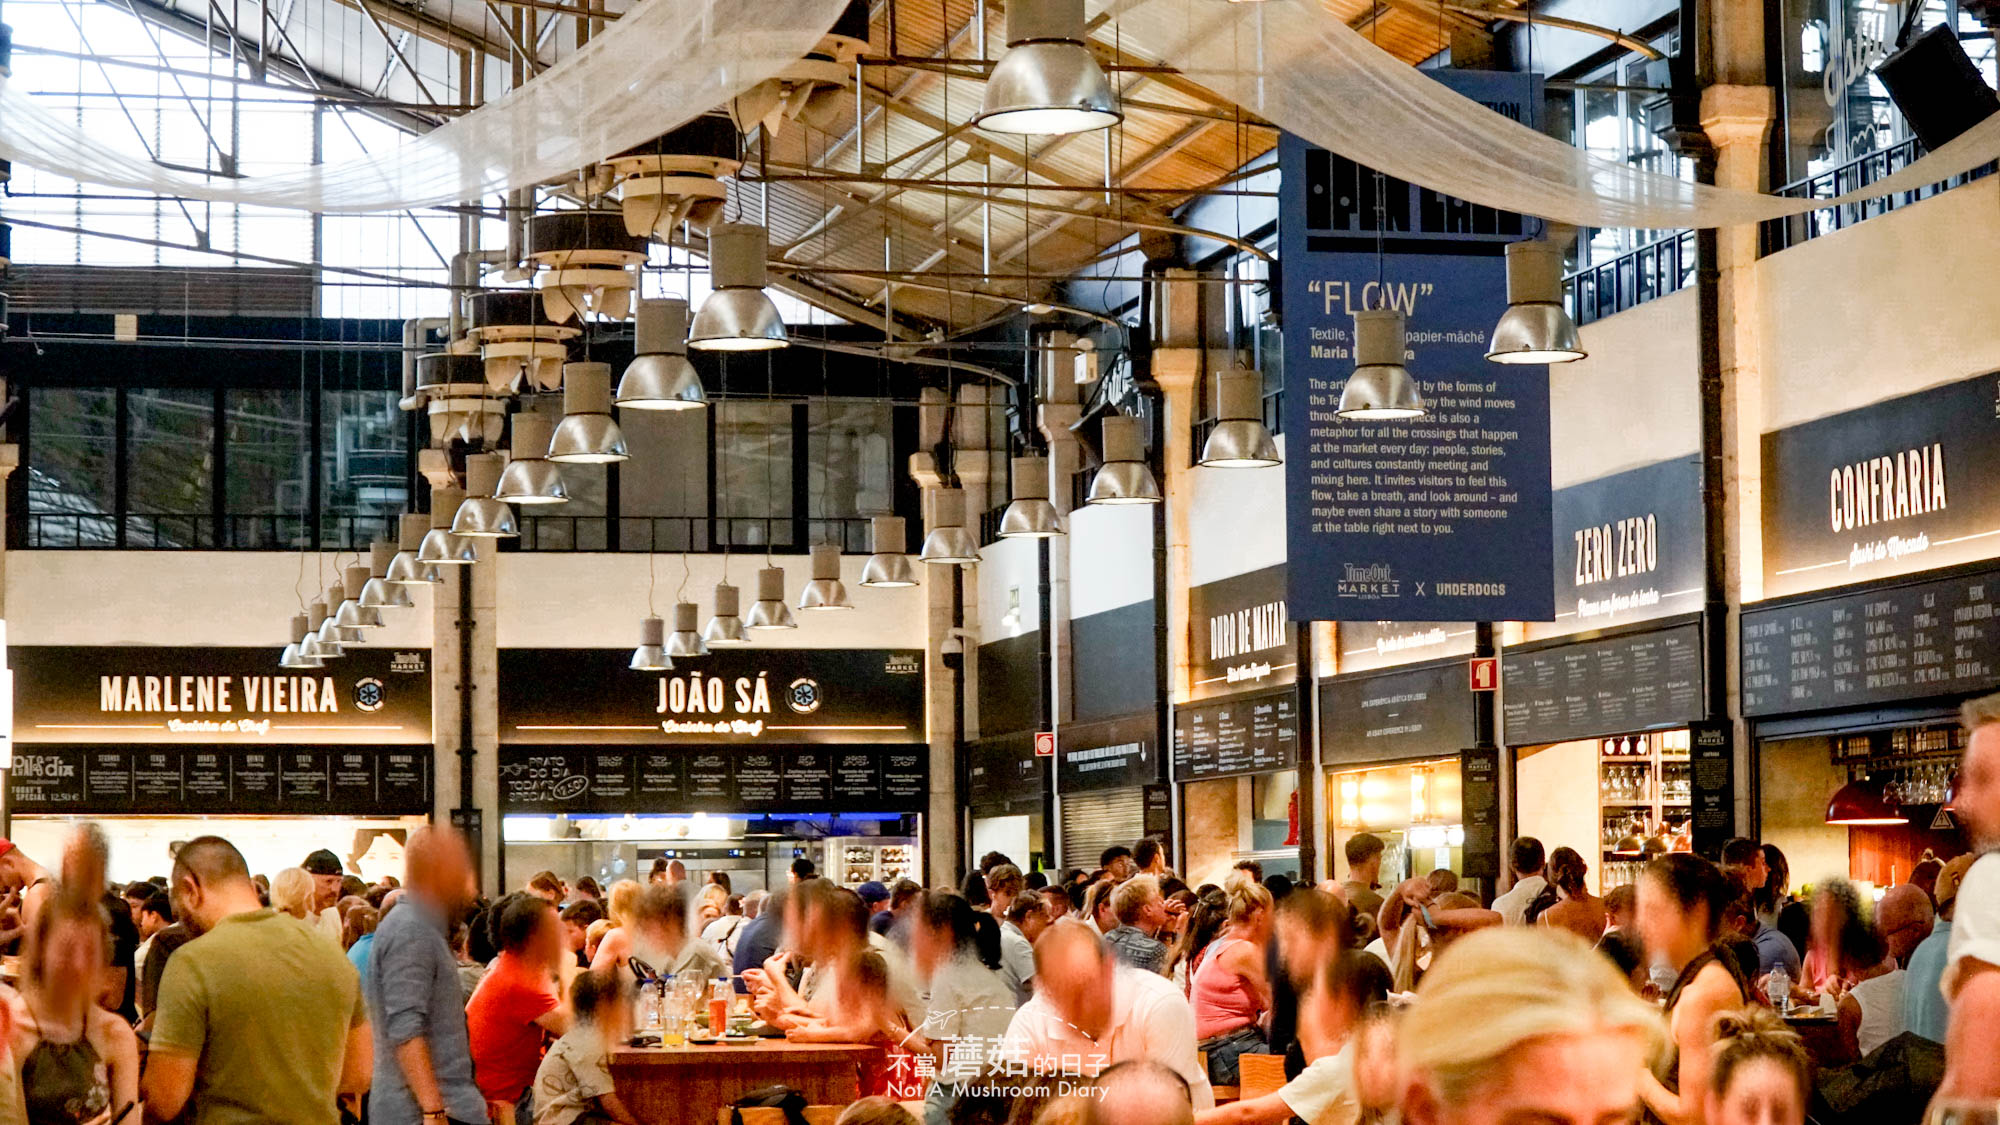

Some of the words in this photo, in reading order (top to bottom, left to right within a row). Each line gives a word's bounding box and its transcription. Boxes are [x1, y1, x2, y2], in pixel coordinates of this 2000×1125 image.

[1310, 327, 1348, 341] Textile,
[1406, 330, 1484, 346] papier-mâché
[1311, 346, 1348, 358] Maria
[1309, 379, 1327, 390] The
[1423, 382, 1434, 393] by
[1437, 381, 1453, 392] the
[1456, 381, 1483, 392] forms
[1486, 382, 1496, 392] of
[1310, 395, 1325, 405] the
[1441, 397, 1456, 407] the
[1459, 397, 1481, 408] wind
[1485, 400, 1515, 408] moves
[1439, 413, 1447, 422] is
[1450, 413, 1470, 423] also
[1310, 428, 1358, 439] metaphor
[1361, 428, 1374, 438] for
[1377, 428, 1389, 438] all
[1393, 429, 1408, 438] the
[1411, 429, 1456, 440] crossings
[1460, 429, 1478, 439] that
[1482, 429, 1518, 440] happen
[1311, 444, 1321, 452] at
[1324, 444, 1339, 453] the
[1343, 444, 1377, 453] market
[1380, 446, 1405, 455] every
[1409, 445, 1429, 455] day:
[1433, 445, 1469, 456] people,
[1472, 445, 1506, 456] stories,
[1311, 459, 1329, 468] and
[1333, 460, 1372, 469] cultures
[1375, 460, 1425, 471] constantly
[1428, 461, 1468, 472] meeting
[1471, 461, 1488, 471] and
[1311, 475, 1344, 486] mixing
[1347, 475, 1371, 485] here.
[1375, 476, 1382, 485] It
[1385, 476, 1415, 486] invites
[1419, 476, 1453, 486] visitors
[1456, 477, 1465, 486] to
[1468, 476, 1486, 486] feel
[1489, 477, 1507, 487] this
[1830, 442, 1946, 533] CONFRARIA
[1312, 491, 1334, 502] flow,
[1337, 491, 1358, 501] take
[1371, 491, 1405, 503] breath,
[1408, 492, 1427, 502] and
[1430, 492, 1451, 502] look
[1454, 492, 1487, 502] around
[1499, 493, 1517, 502] and
[1312, 507, 1344, 518] maybe
[1348, 509, 1371, 517] even
[1374, 507, 1401, 517] share
[1413, 508, 1437, 519] story
[1440, 507, 1460, 518] with
[1463, 510, 1507, 518] someone
[1312, 524, 1322, 532] at
[1325, 523, 1341, 532] the
[1344, 523, 1369, 533] table
[1372, 524, 1395, 535] right
[1398, 525, 1418, 533] next
[1421, 525, 1431, 533] to
[1434, 527, 1453, 535] you.
[1575, 523, 1613, 586] ZERO
[1617, 512, 1657, 578] ZERO
[1338, 583, 1400, 593] MARKET
[1415, 582, 1425, 596] X
[1436, 583, 1506, 596] UNDERDOGS
[1210, 612, 1236, 661] DURO
[1238, 608, 1251, 655] DE
[1253, 600, 1288, 651] MATAR
[100, 675, 232, 713] MARLENE
[243, 676, 339, 714] VIEIRA
[656, 671, 724, 714] JOÃO
[734, 671, 772, 714] SÁ
[168, 718, 220, 732] Cozinha
[238, 718, 270, 736] Chef
[662, 719, 714, 733] Cozinha
[731, 719, 762, 736] Chef
[529, 768, 548, 778] DO
[552, 768, 570, 778] DIA
